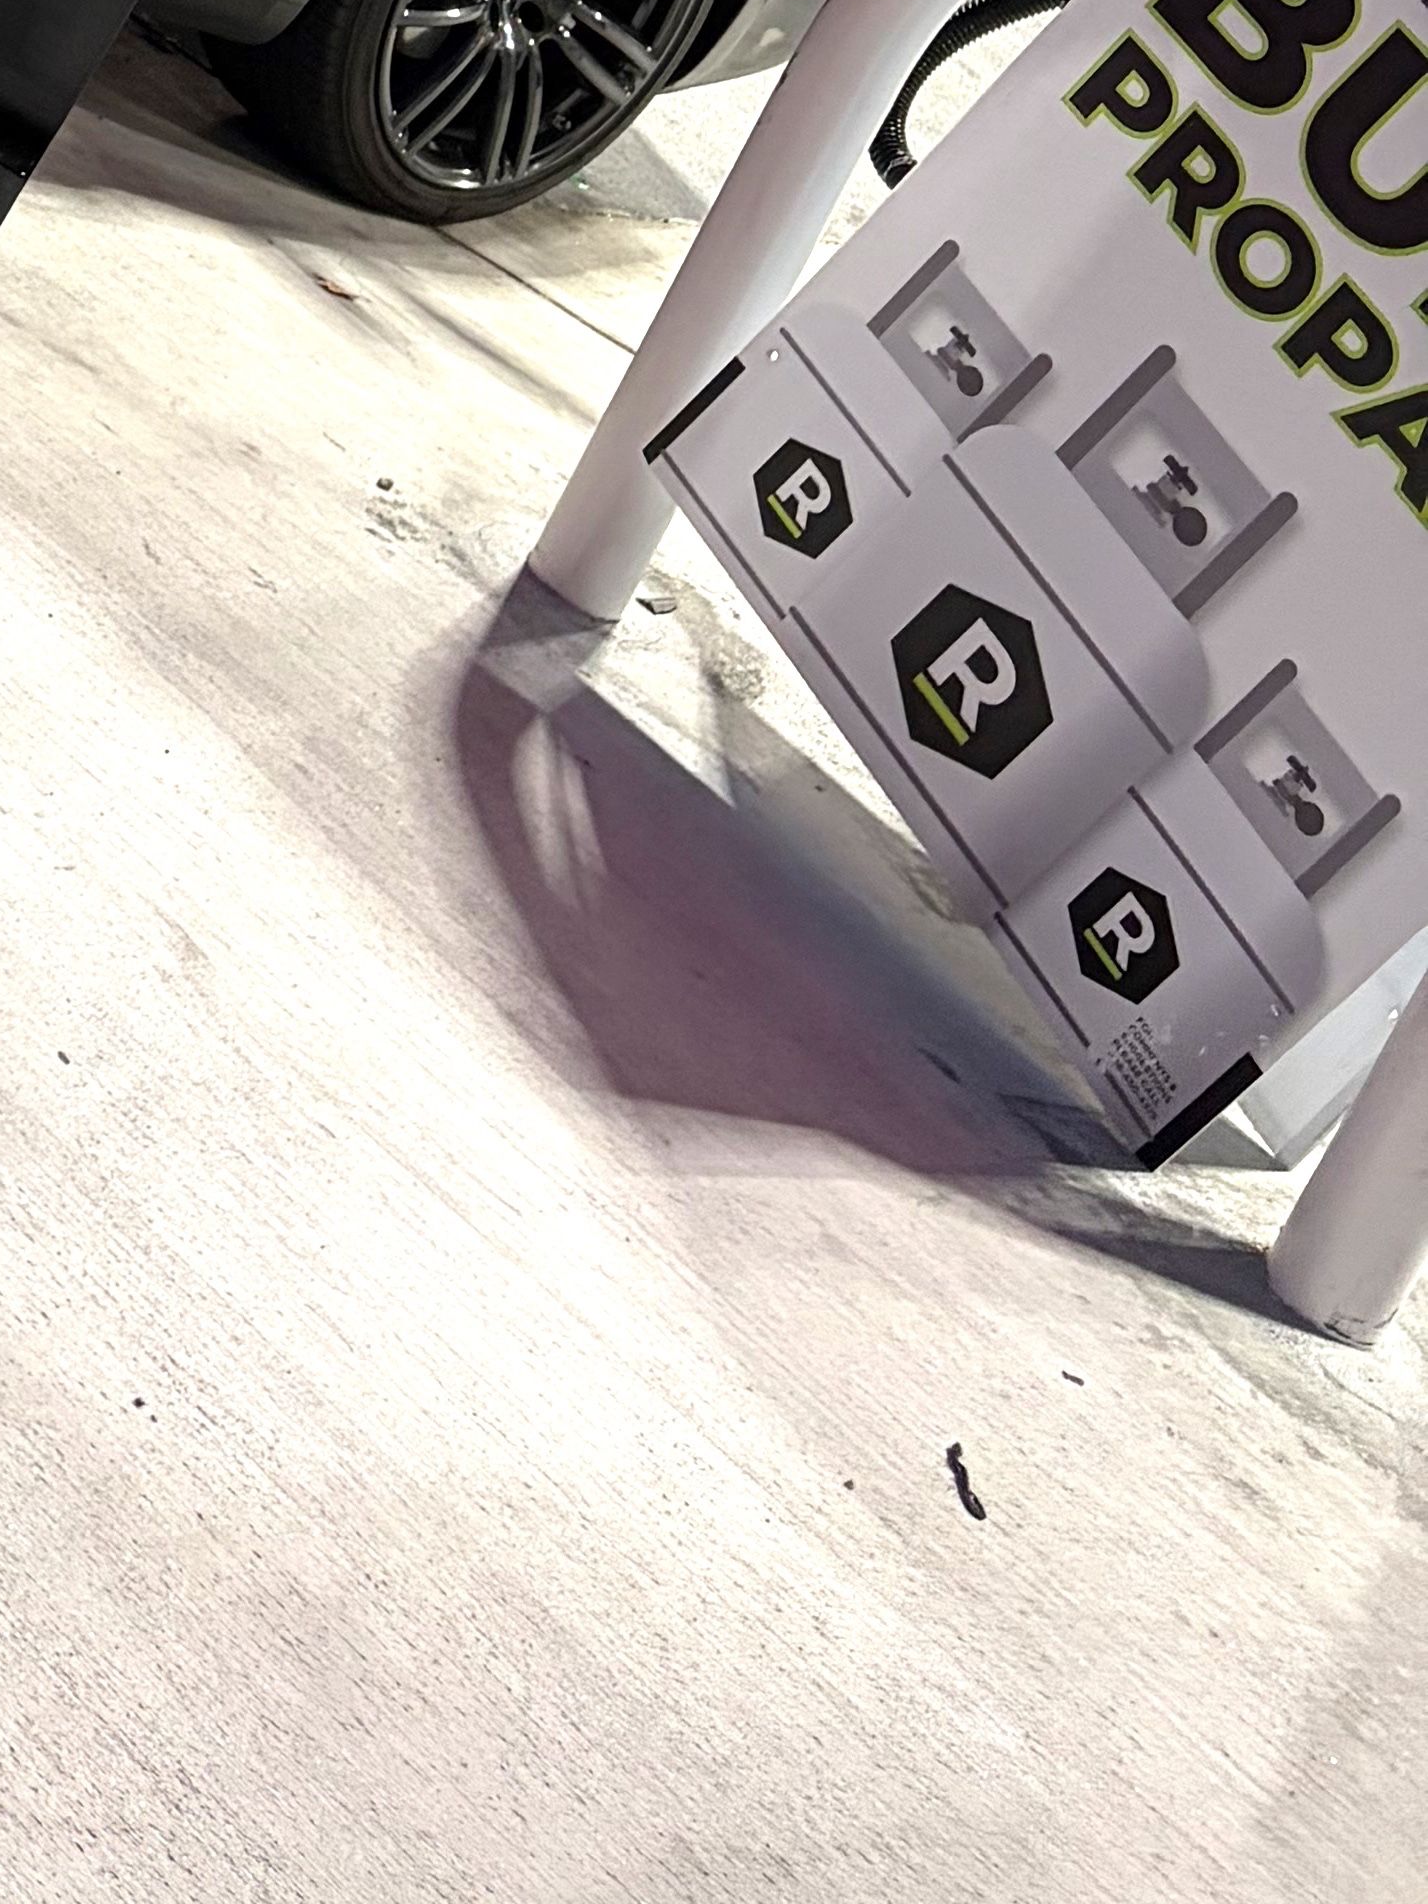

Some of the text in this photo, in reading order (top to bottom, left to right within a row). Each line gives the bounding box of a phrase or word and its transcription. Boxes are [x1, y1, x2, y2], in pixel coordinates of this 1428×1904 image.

[929, 618, 1017, 734] R
[1094, 891, 1157, 974] R
[1109, 1038, 1143, 1078] PLEASE
[1137, 1078, 1163, 1106] CALL
